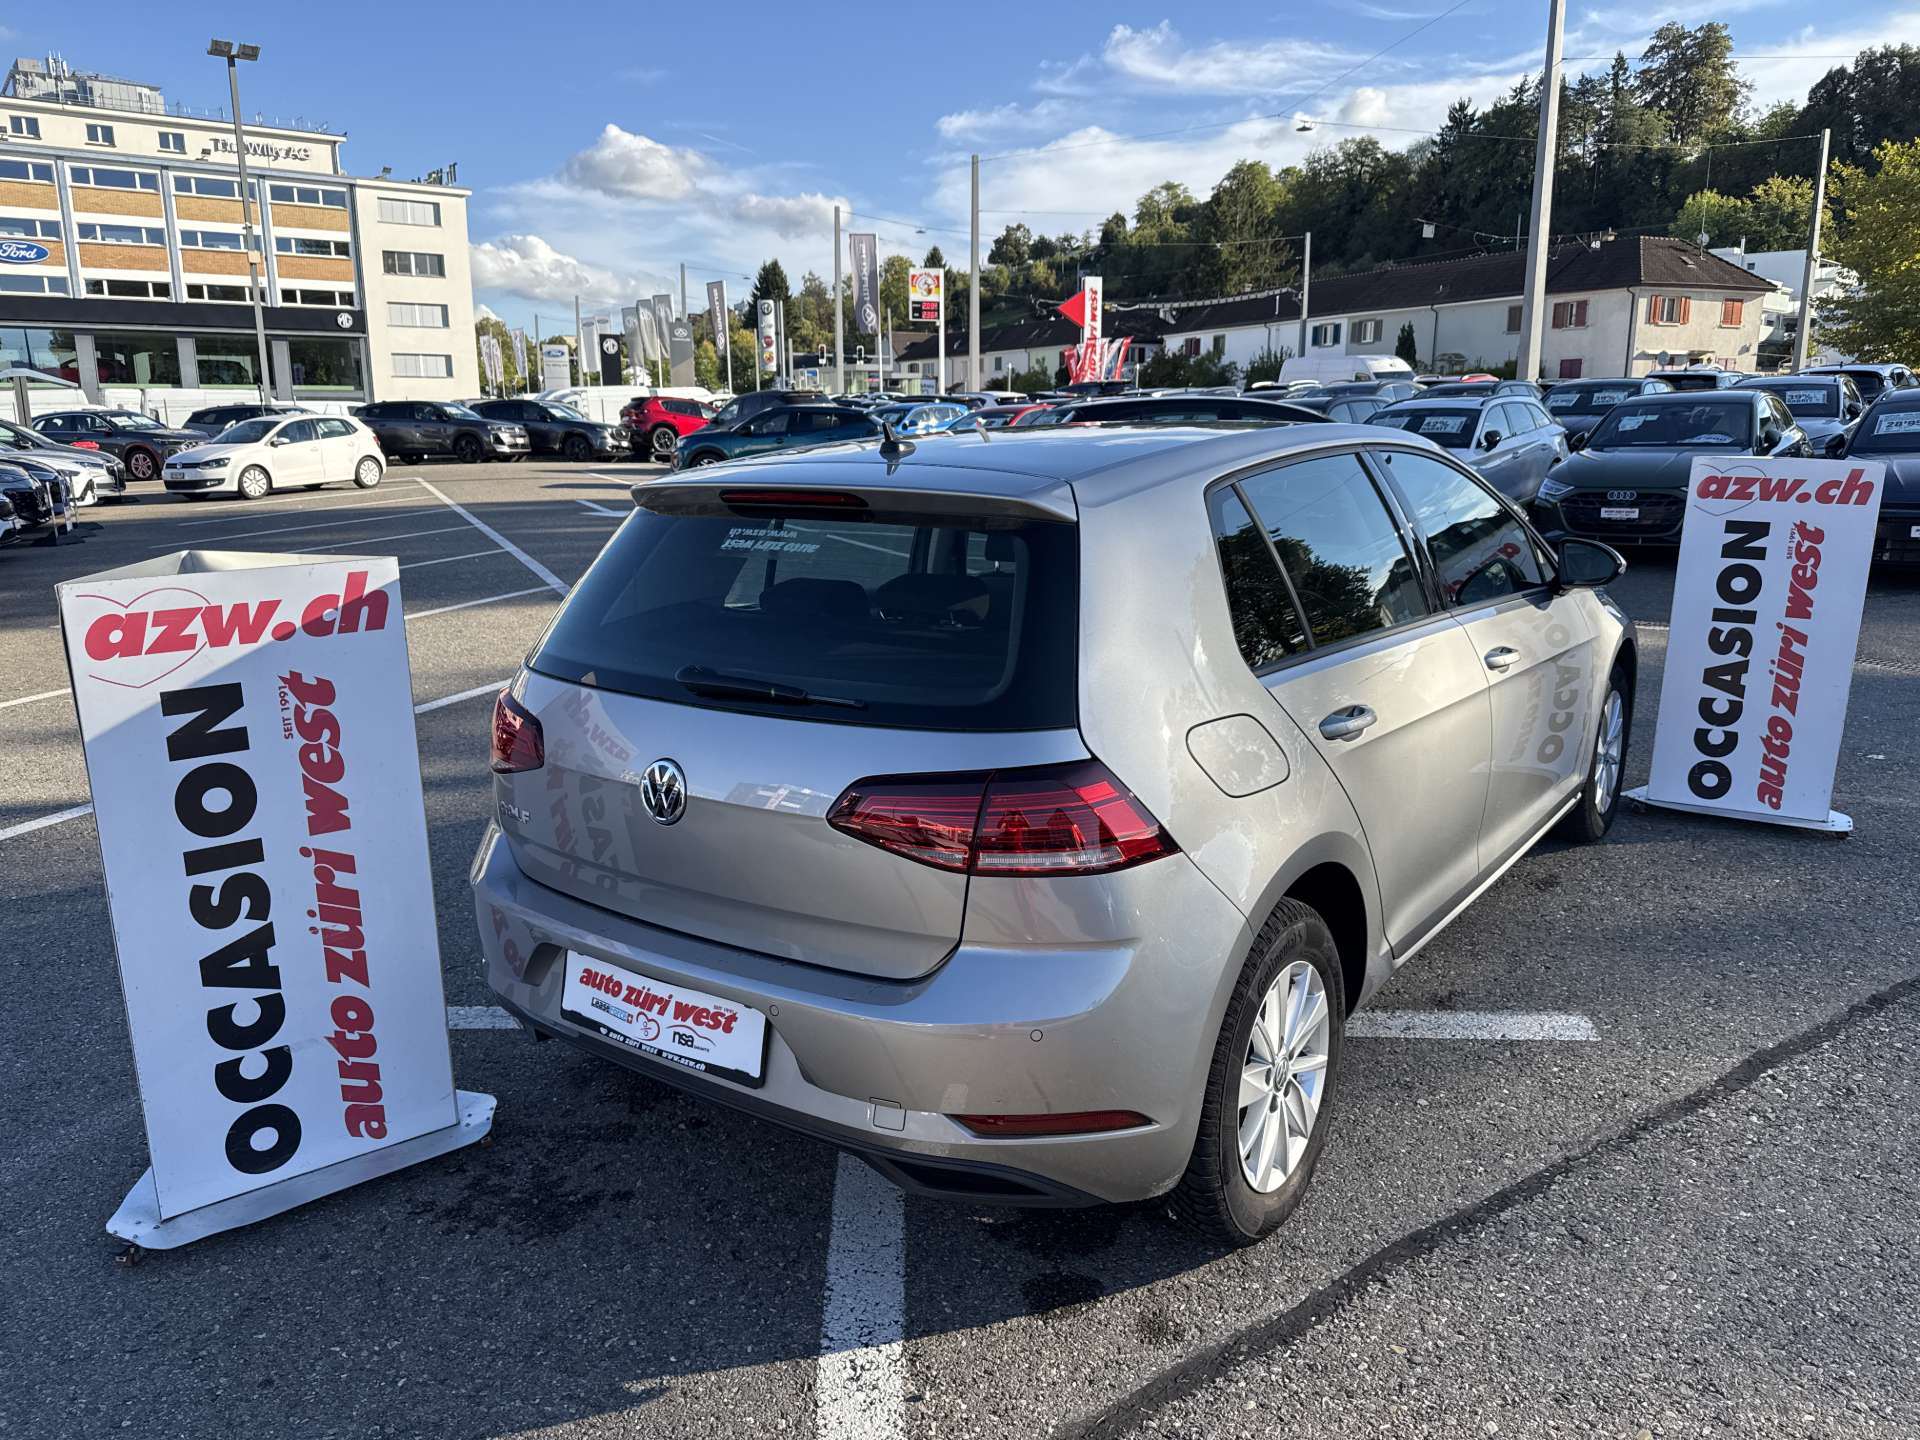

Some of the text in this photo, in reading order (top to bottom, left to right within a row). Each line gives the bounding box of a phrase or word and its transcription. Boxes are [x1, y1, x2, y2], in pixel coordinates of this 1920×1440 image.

[0, 243, 37, 258] Ford
[1696, 469, 1874, 506] azw.ch
[84, 571, 389, 661] azw.ch
[1687, 519, 1771, 800] OCCASION
[1757, 520, 1825, 811] auto züri west
[278, 684, 294, 740] SEIT 1991
[160, 682, 302, 1175] OCCASION
[278, 670, 388, 1140] auto züri west
[579, 968, 623, 997] auto
[622, 986, 673, 1016] züri
[673, 1001, 738, 1034] west
[672, 1030, 695, 1048] nsa
